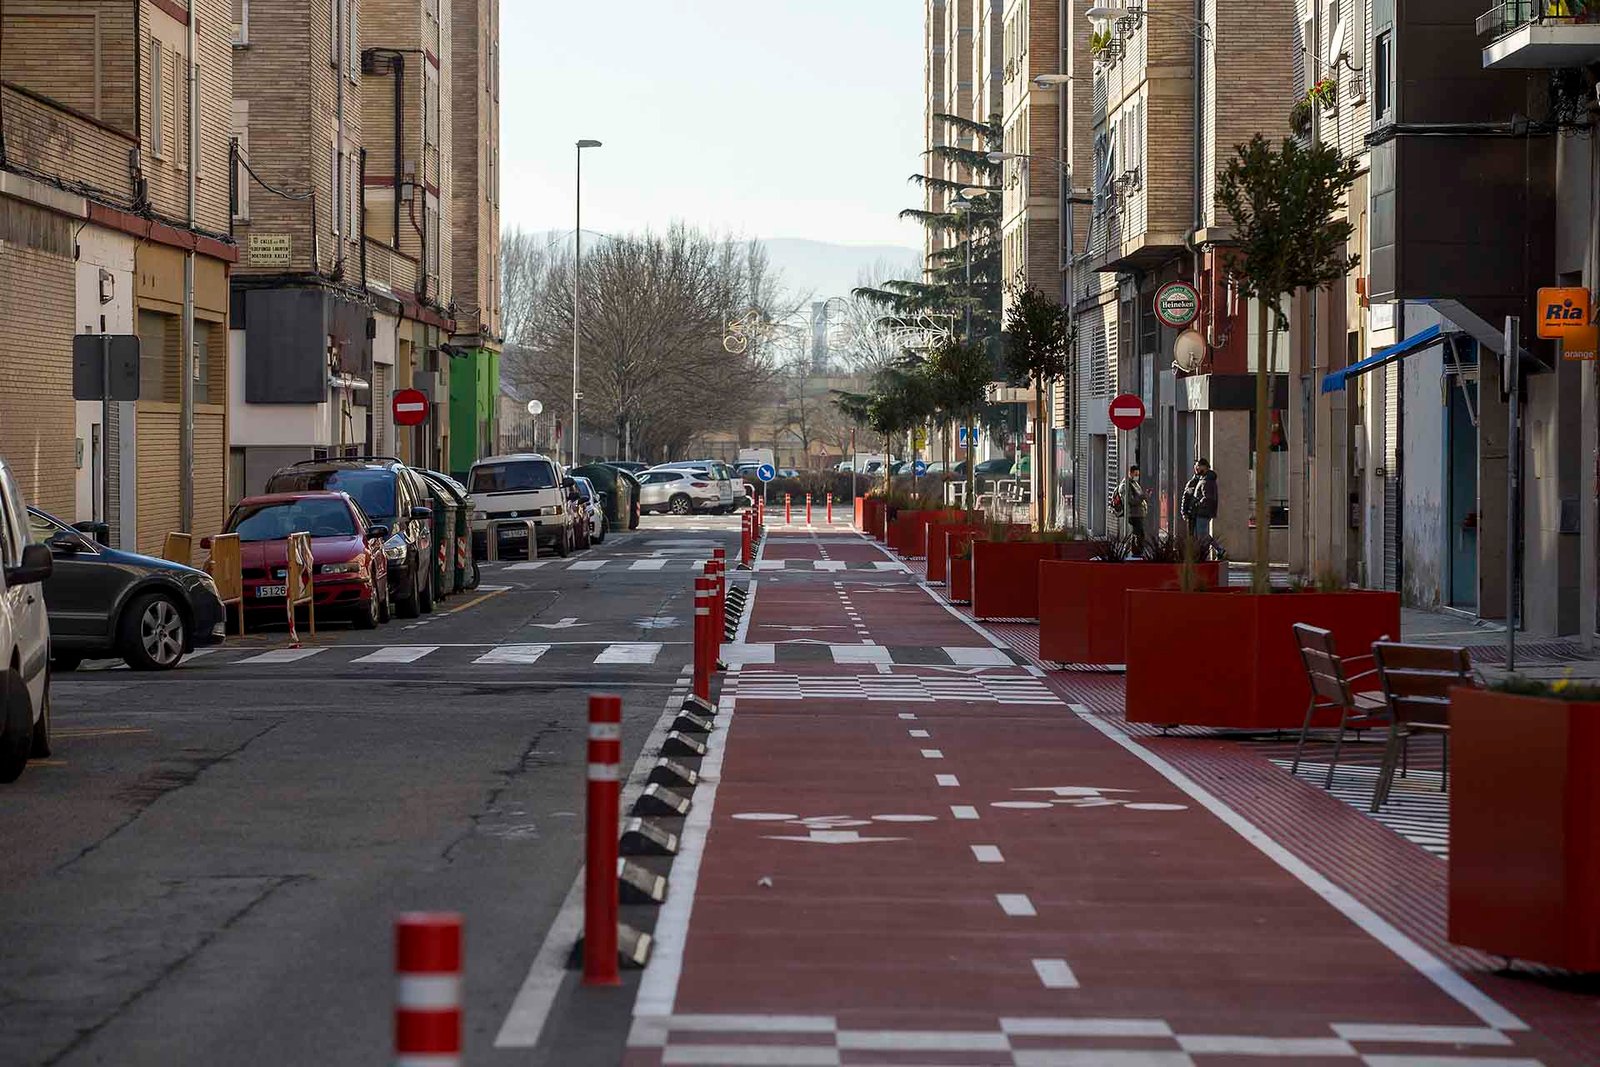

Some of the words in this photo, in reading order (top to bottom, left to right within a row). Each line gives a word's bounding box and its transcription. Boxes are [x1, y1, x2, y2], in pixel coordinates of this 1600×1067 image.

[1546, 298, 1583, 320] Ria
[1564, 351, 1594, 359] orange
[262, 586, 286, 596] 5126
